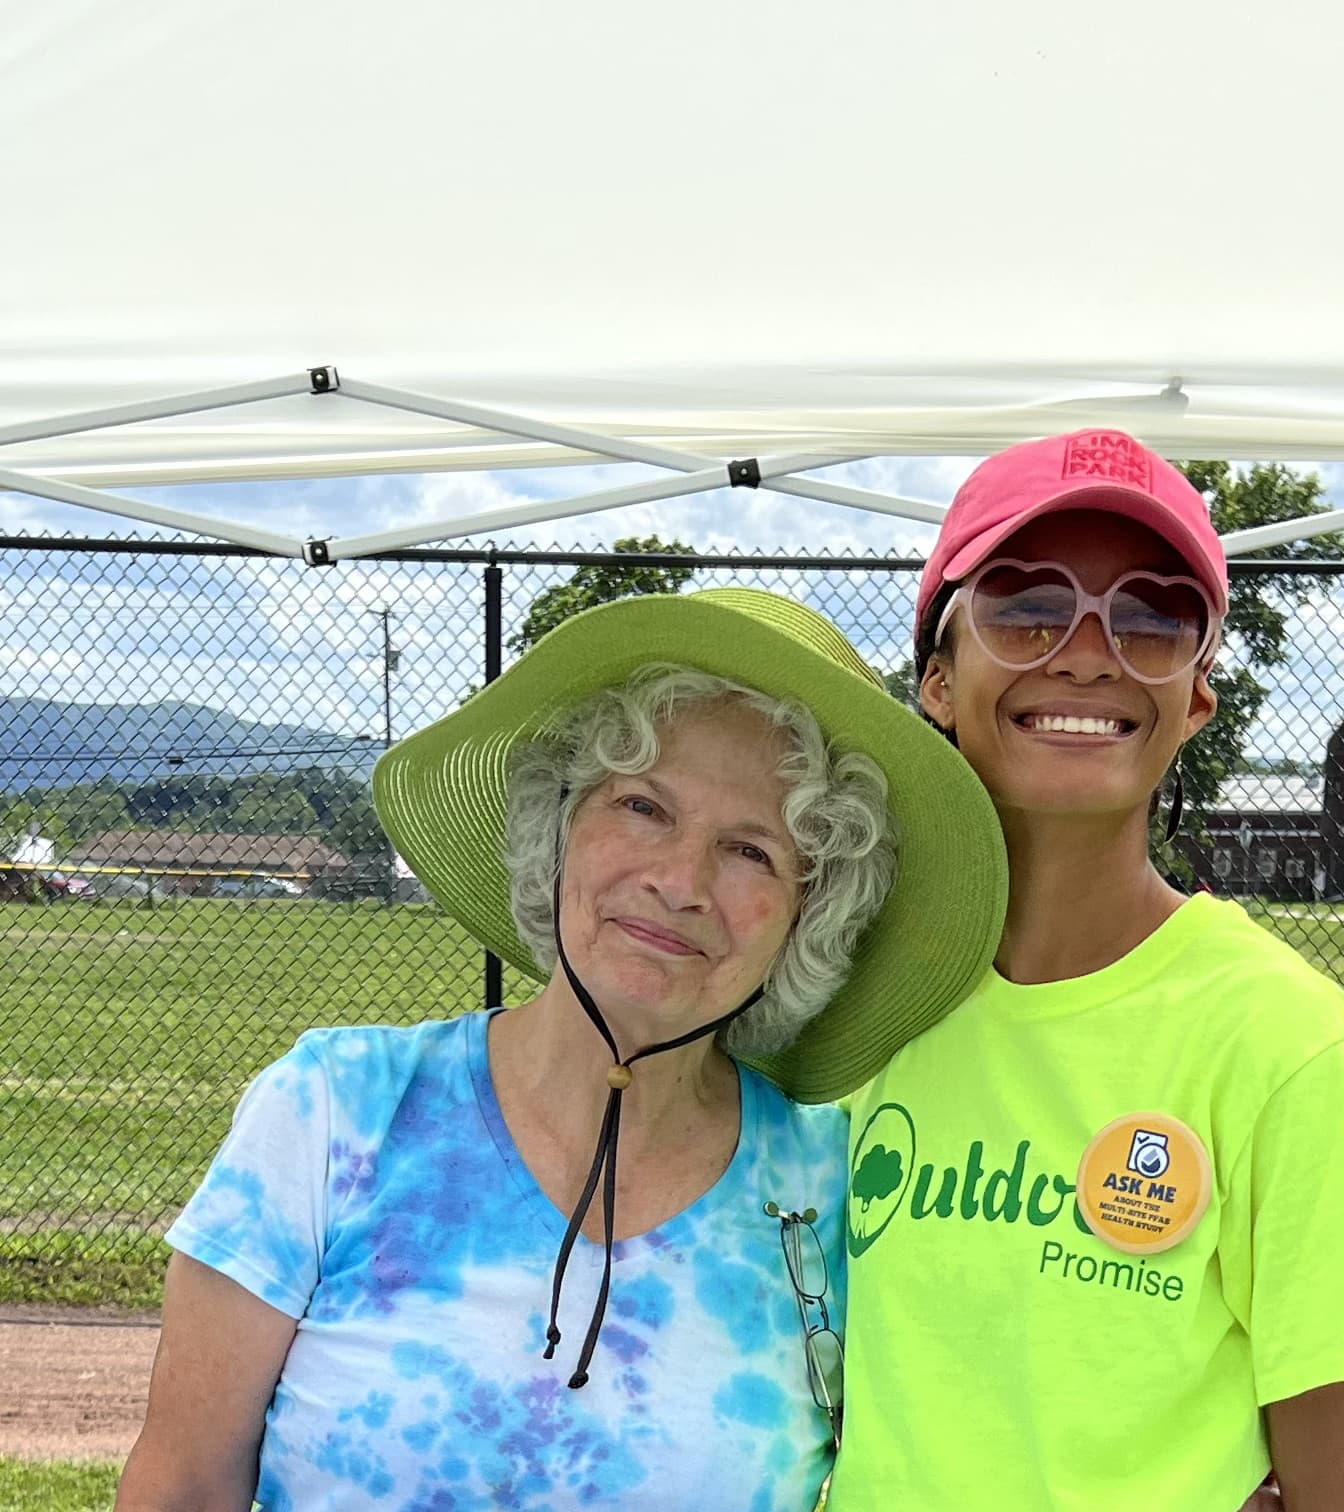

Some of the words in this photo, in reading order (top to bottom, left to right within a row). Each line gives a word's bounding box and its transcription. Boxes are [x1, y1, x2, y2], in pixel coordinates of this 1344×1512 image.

[1070, 448, 1146, 474] ROCK
[1069, 462, 1146, 489] PARK
[1102, 1173, 1143, 1195] ASK
[1146, 1182, 1177, 1203] ME
[1039, 1240, 1185, 1302] Promise
